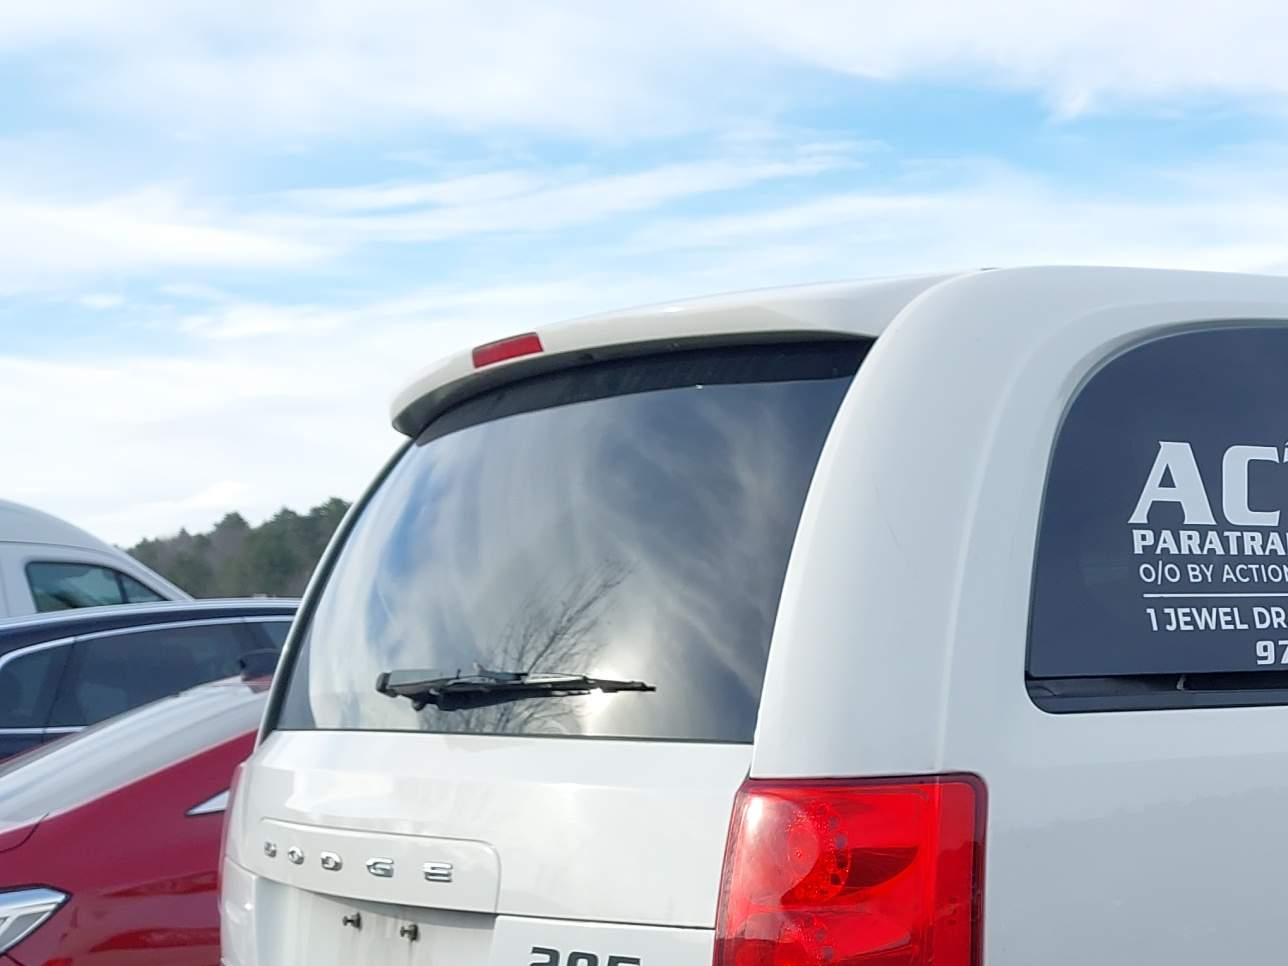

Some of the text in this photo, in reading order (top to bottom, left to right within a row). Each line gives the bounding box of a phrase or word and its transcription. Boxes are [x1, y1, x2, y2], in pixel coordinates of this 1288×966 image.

[1139, 560, 1181, 585] O/O
[1187, 564, 1214, 583] BY
[1146, 608, 1158, 631] 1
[1163, 607, 1249, 631] JEWEL
